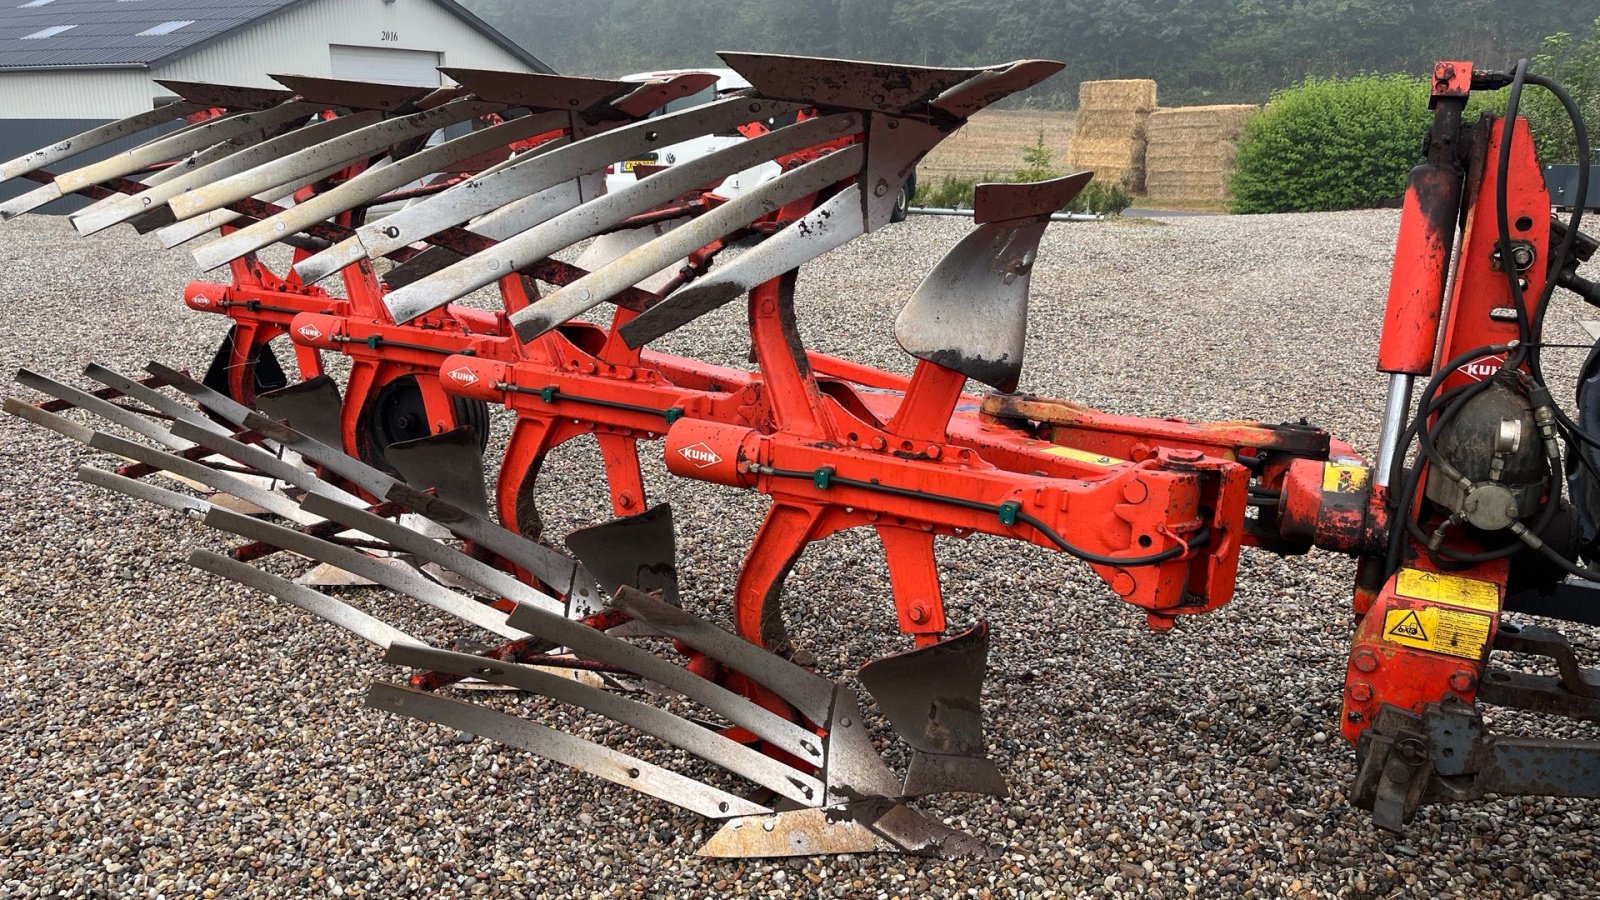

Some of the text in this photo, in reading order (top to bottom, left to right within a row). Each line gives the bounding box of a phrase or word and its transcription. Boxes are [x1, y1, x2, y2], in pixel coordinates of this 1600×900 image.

[381, 31, 398, 41] 2016
[301, 328, 319, 336] KUHN
[452, 371, 474, 382] KUHN
[684, 448, 716, 463] KUHN
